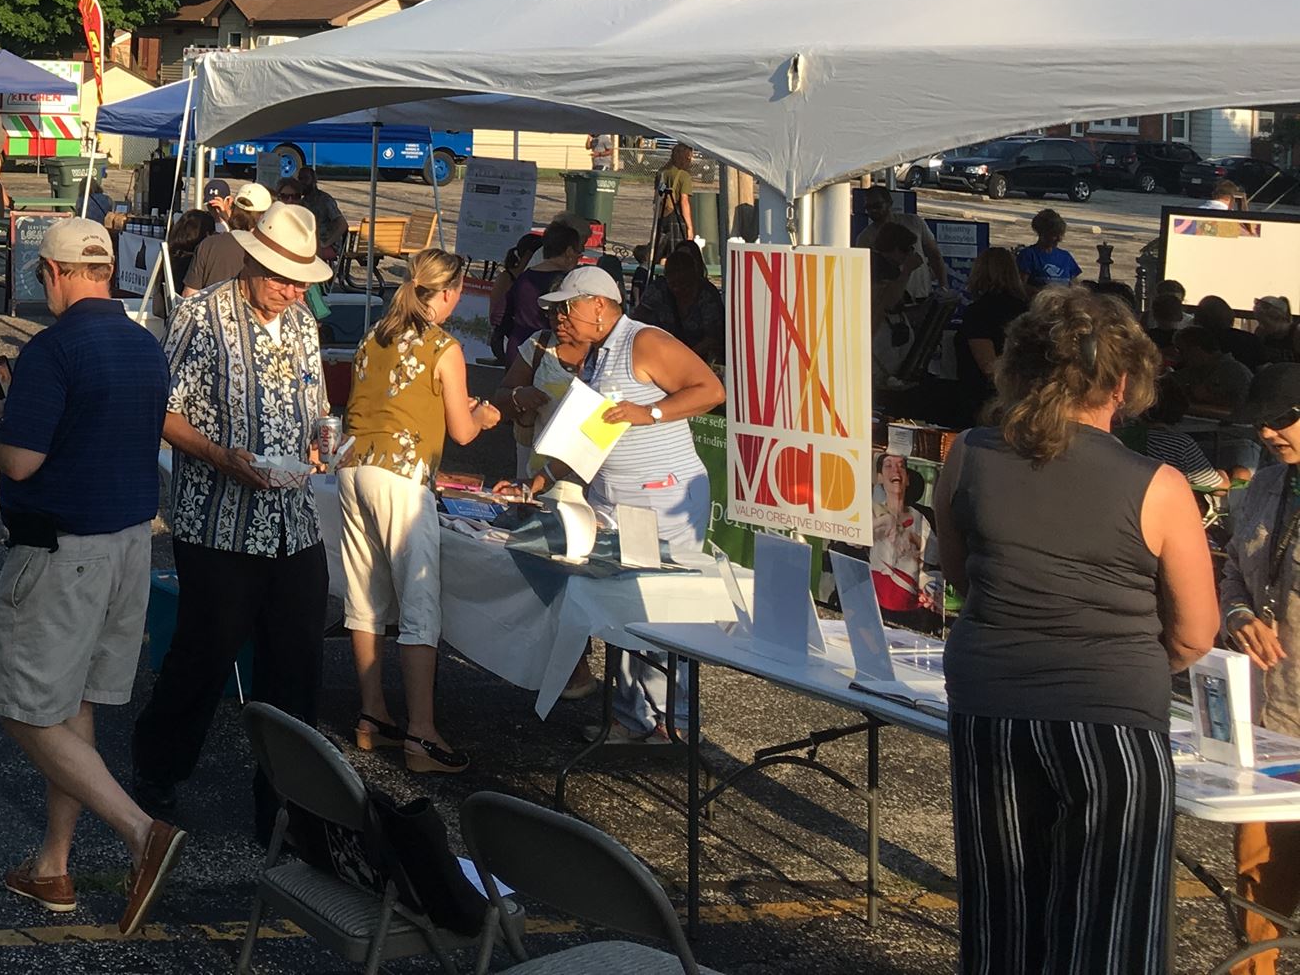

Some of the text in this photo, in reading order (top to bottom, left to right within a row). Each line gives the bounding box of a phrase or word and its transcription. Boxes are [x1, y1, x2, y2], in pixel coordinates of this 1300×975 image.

[11, 93, 61, 102] KITCHEN
[709, 417, 727, 429] self-
[703, 433, 727, 449] indivi
[735, 504, 765, 520] VALPO
[766, 511, 812, 530] CREATIVE
[814, 519, 862, 539] DISTRICT
